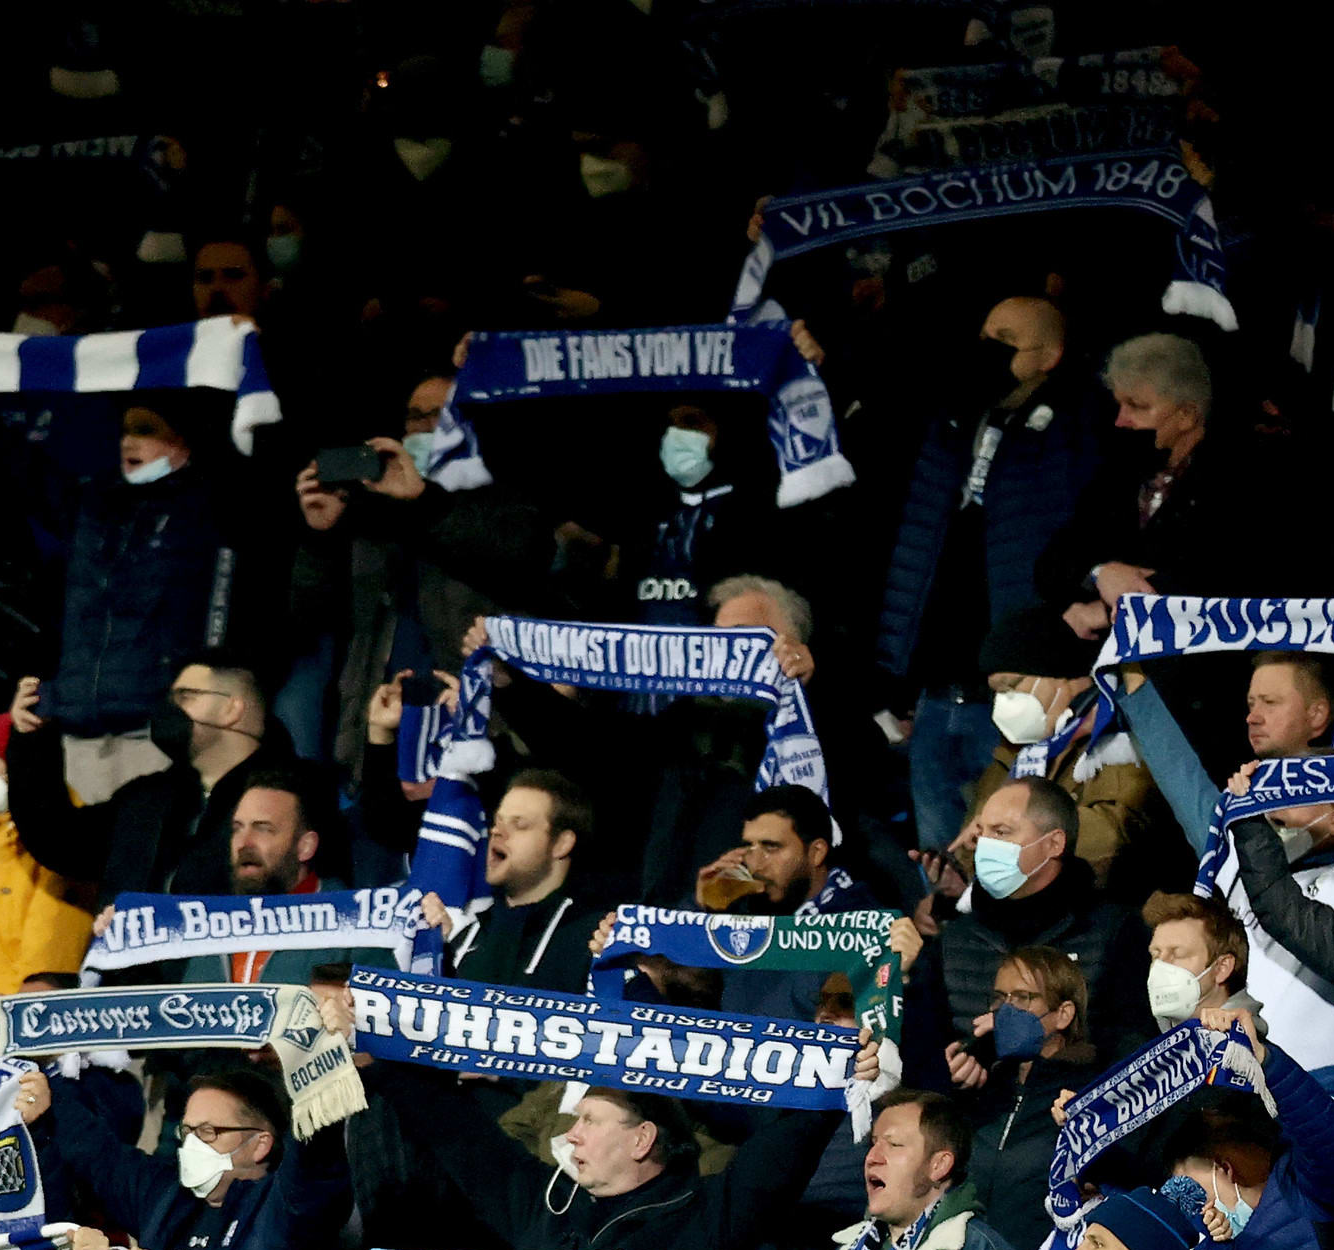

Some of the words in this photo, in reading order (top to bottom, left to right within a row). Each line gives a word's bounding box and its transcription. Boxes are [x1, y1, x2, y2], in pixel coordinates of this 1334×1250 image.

[870, 163, 1079, 220] BOCHUM
[1093, 160, 1189, 200] 1848
[523, 337, 564, 381] DIE
[568, 337, 632, 381] FANS
[636, 336, 691, 379] VOM
[518, 622, 623, 674] KOMMST
[624, 634, 654, 677] DU
[656, 635, 686, 678] IN
[688, 637, 728, 682] EIN
[543, 668, 581, 685] BLAU
[103, 910, 168, 948] VfL
[184, 896, 338, 939] Bochum
[20, 1002, 153, 1040] Castroper
[352, 969, 476, 998] Unsere
[630, 1006, 753, 1035] Unsere
[760, 1018, 860, 1045] Liebe
[353, 986, 856, 1091] RUHRSTADION
[290, 1046, 347, 1092] BOCHUM
[410, 1044, 470, 1068] Für
[620, 1070, 688, 1093] Und
[696, 1080, 789, 1105] Ewig
[1103, 1041, 1203, 1123] BOCHUM
